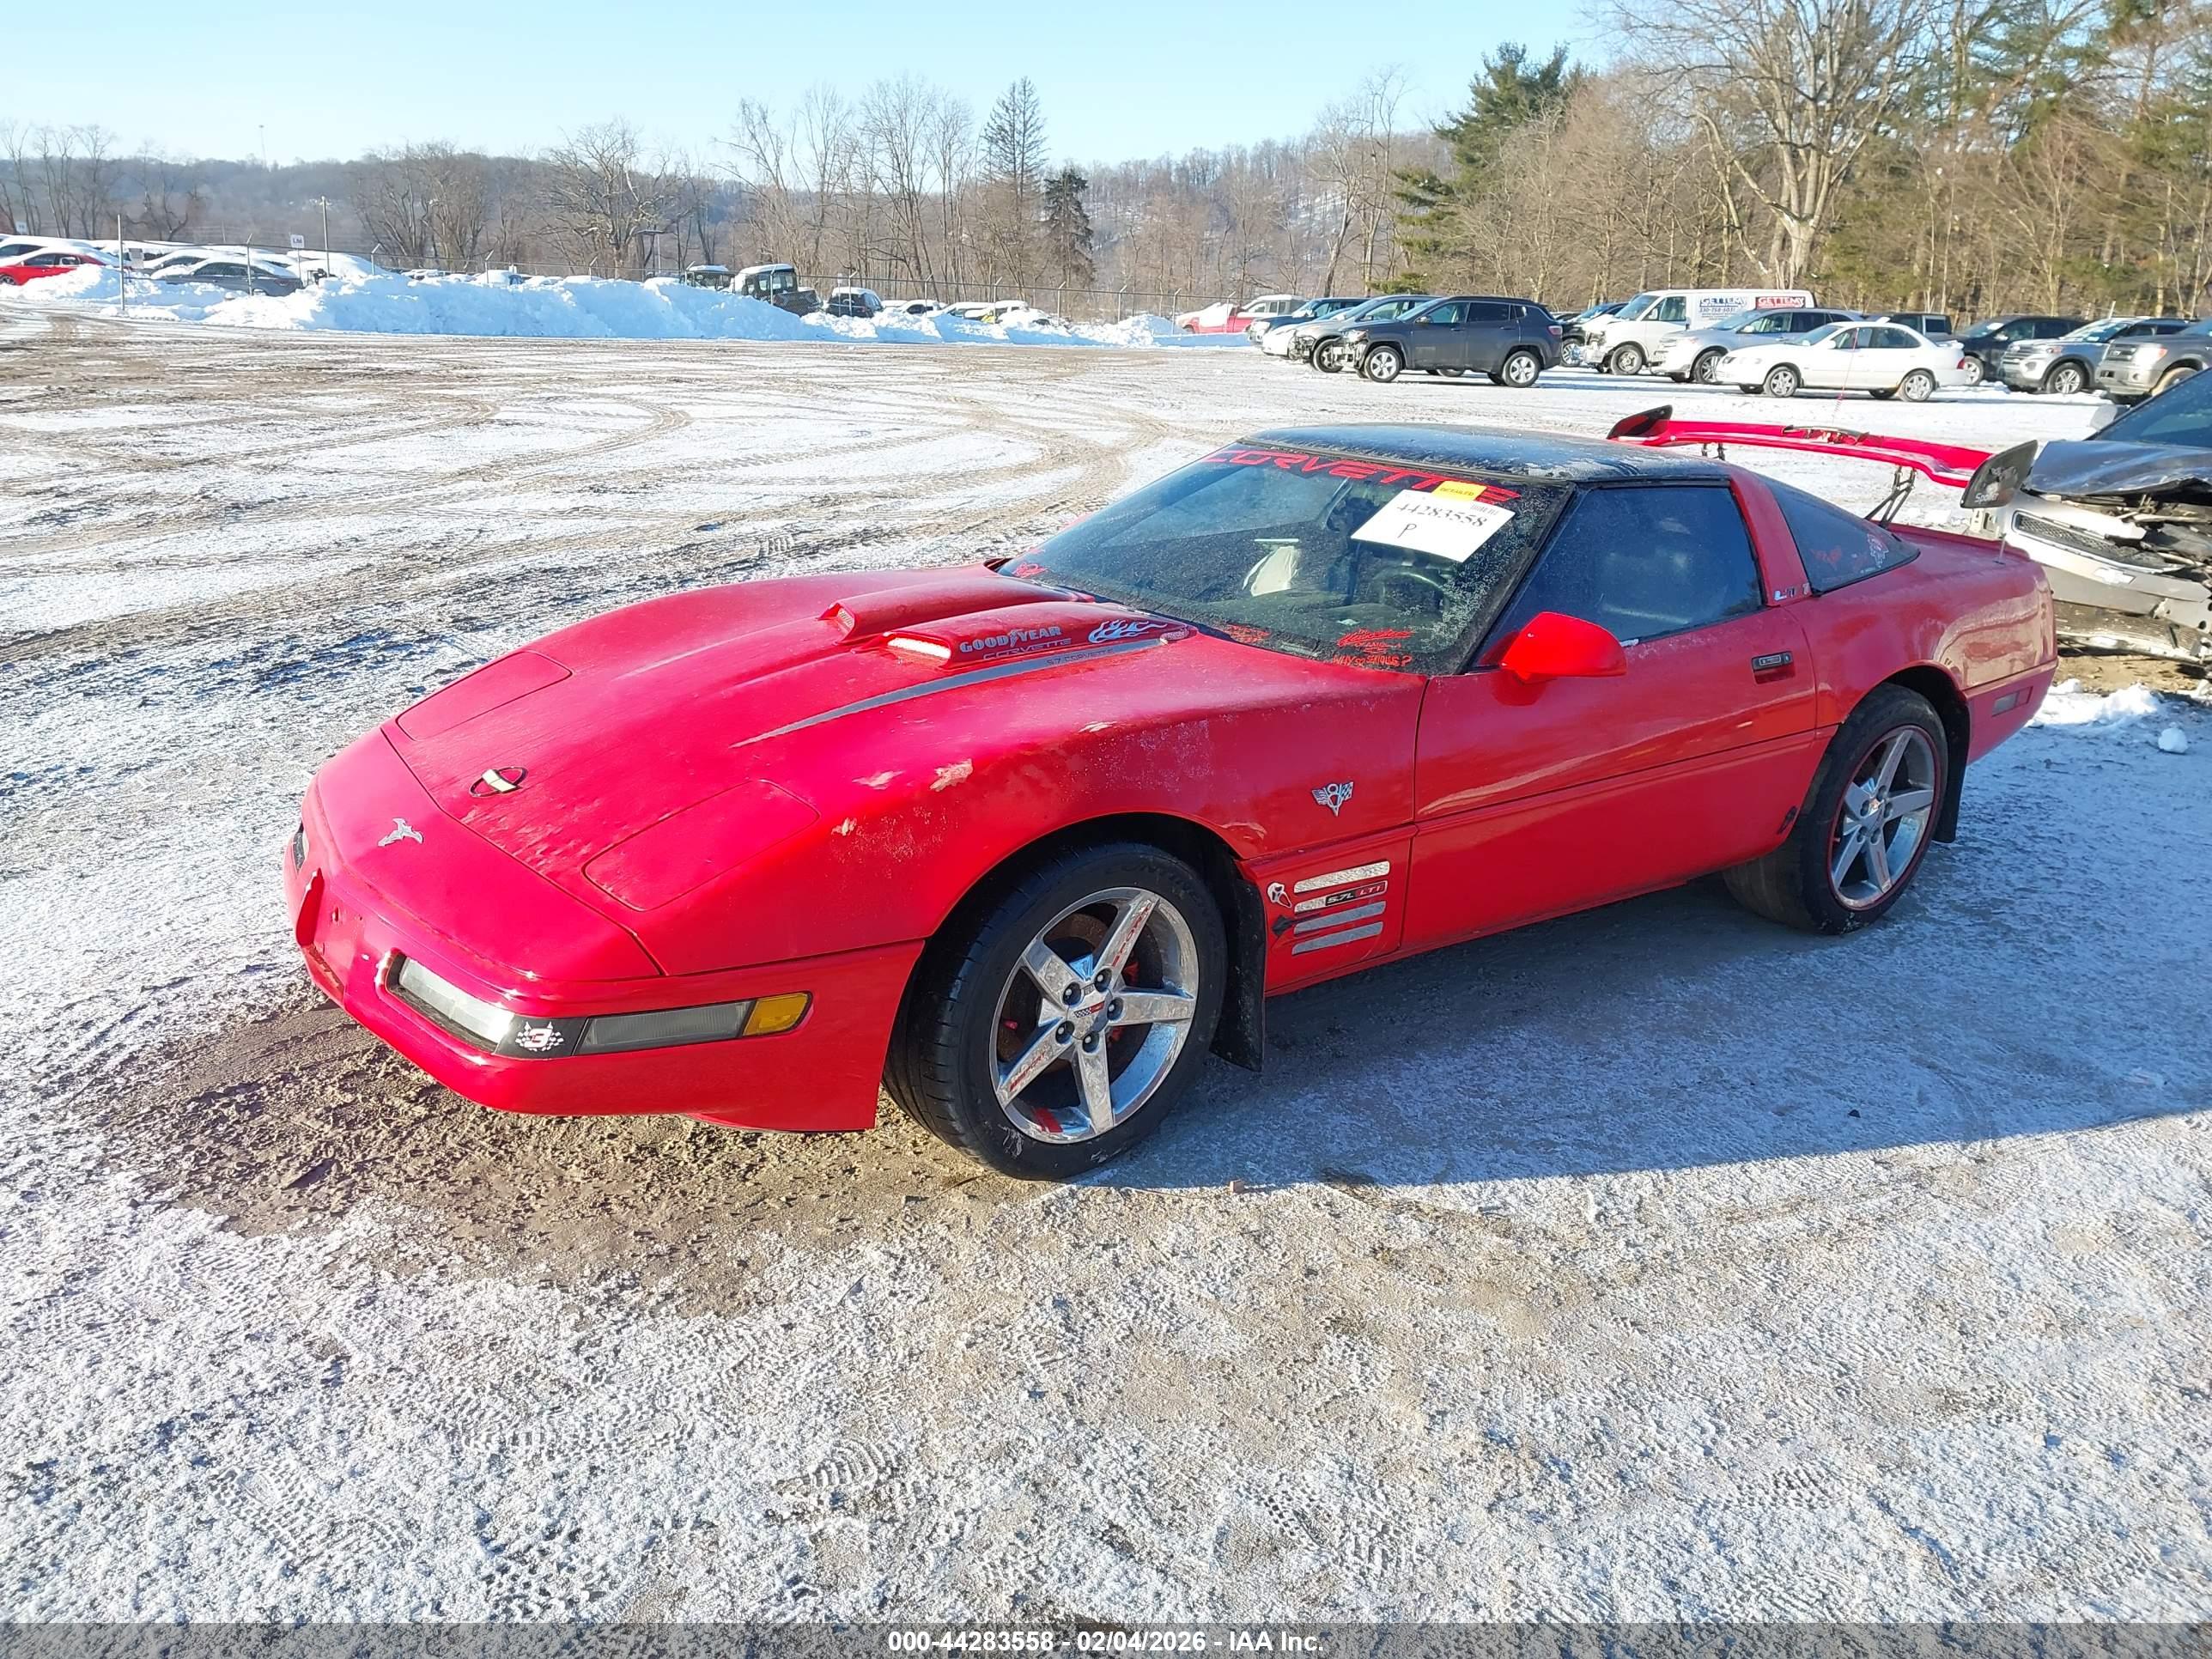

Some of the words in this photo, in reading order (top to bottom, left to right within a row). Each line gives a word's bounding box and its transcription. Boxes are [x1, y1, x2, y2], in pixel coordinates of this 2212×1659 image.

[1757, 297, 1804, 306] GETTEMY
[1202, 449, 1521, 503] CORVETTE
[1398, 503, 1487, 527] 44283558
[959, 626, 1062, 653] GOODYEAR
[983, 638, 1073, 659] CORVETTE
[1327, 892, 1354, 904] 5.7L
